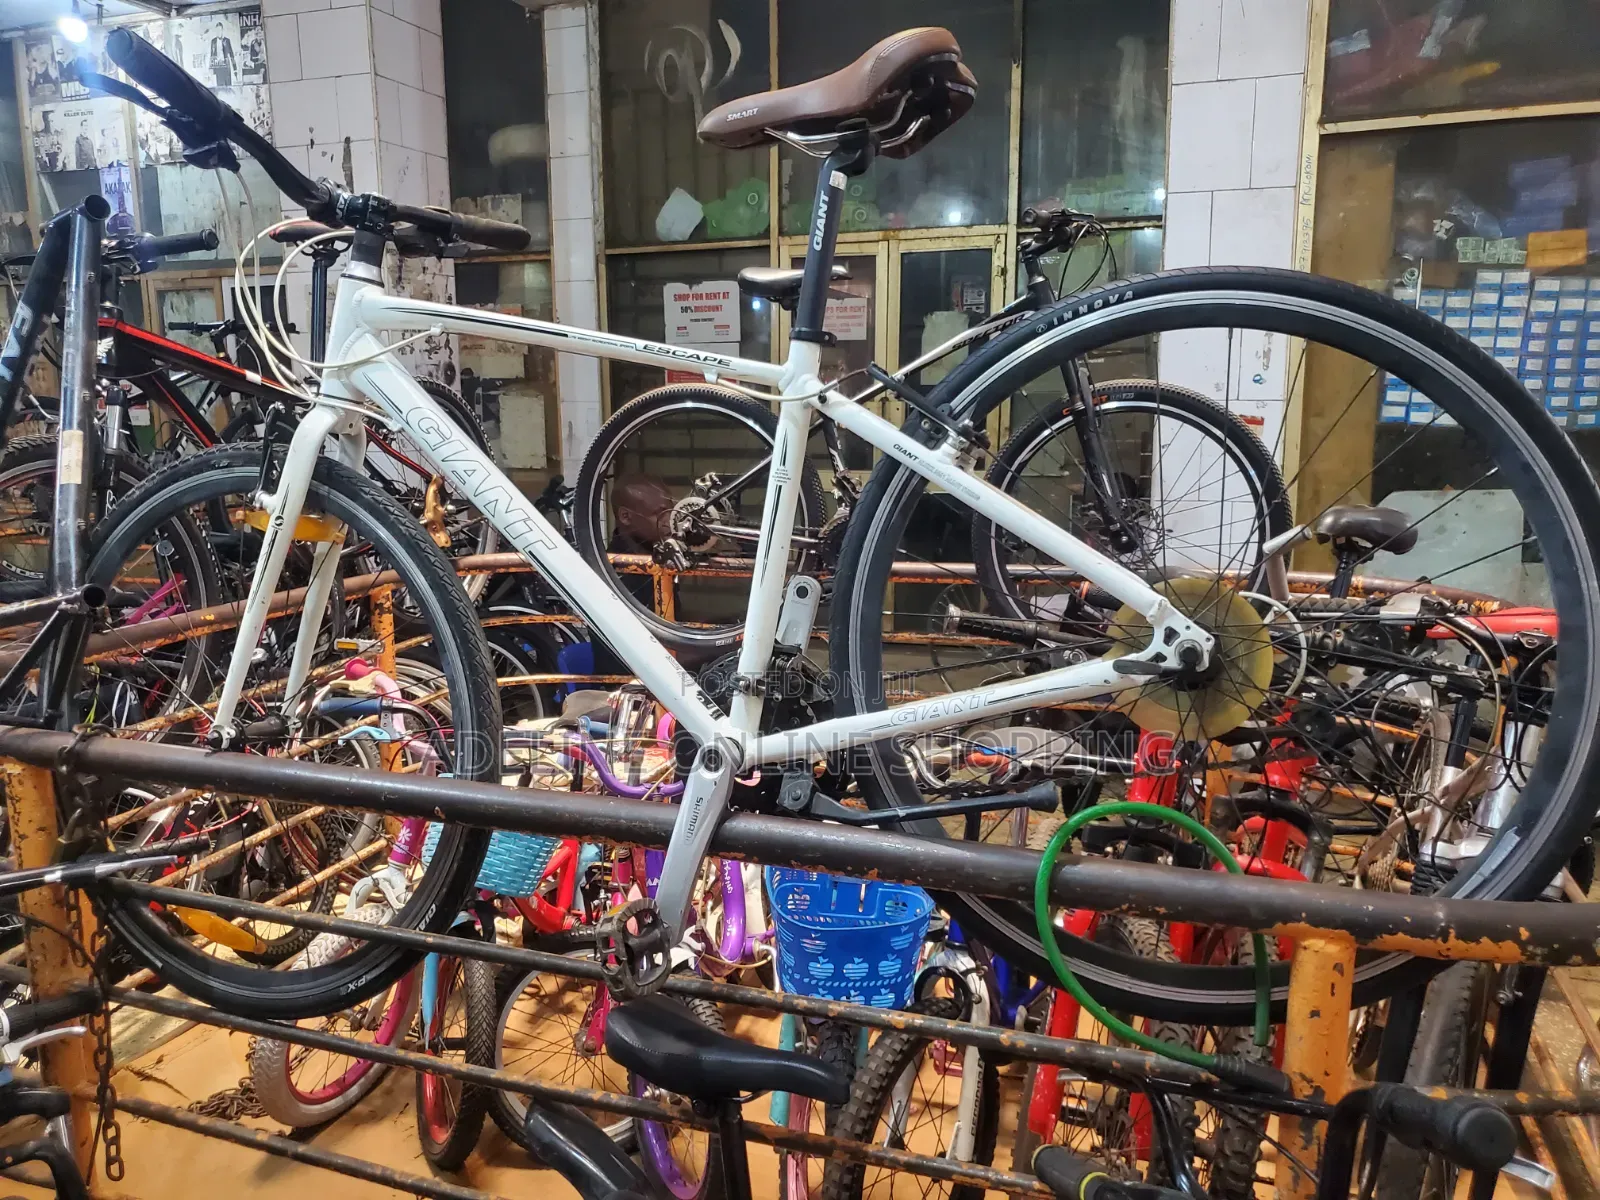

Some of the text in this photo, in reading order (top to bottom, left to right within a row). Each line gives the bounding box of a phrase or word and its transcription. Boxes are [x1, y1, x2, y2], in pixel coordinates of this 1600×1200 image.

[726, 107, 759, 122] SMART
[813, 190, 829, 251] GIANT
[673, 291, 730, 302] SHOP FOR RENT AT
[1052, 290, 1134, 326] INNOVA
[680, 304, 723, 314] 50% DISCOUNT
[642, 343, 733, 367] ESCAPE
[893, 443, 919, 462] GIANT
[404, 406, 557, 553] GIANT
[891, 690, 997, 726] GIANT
